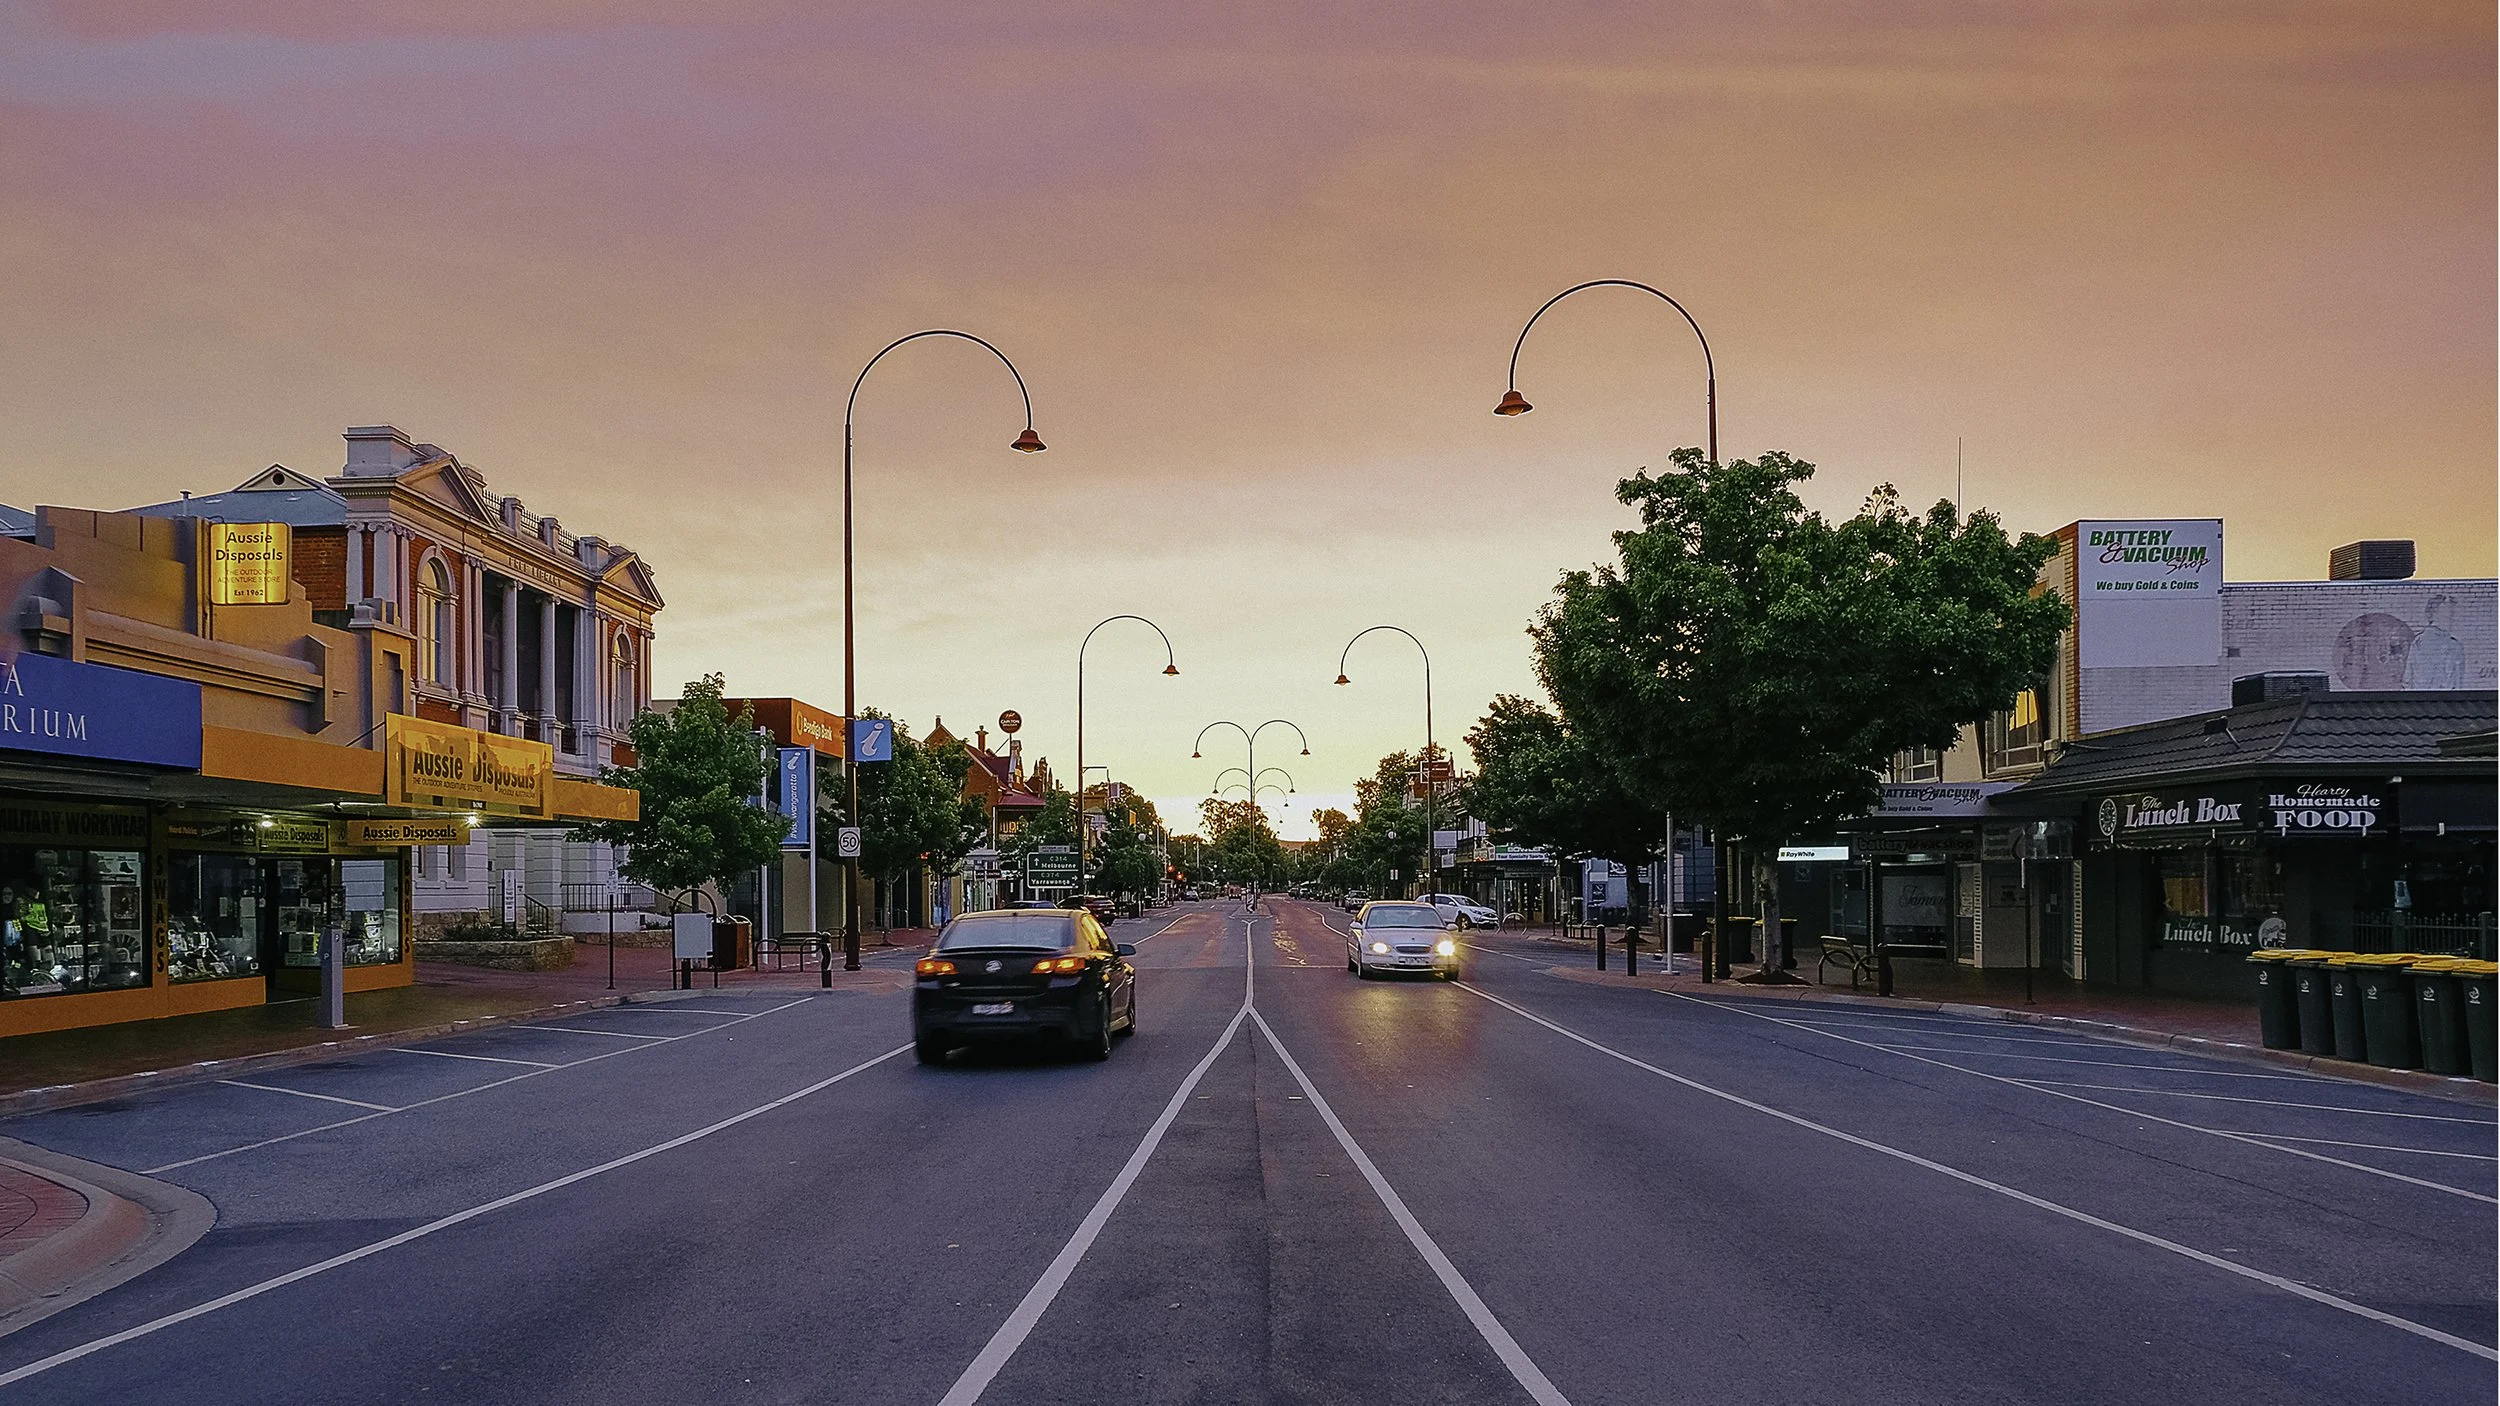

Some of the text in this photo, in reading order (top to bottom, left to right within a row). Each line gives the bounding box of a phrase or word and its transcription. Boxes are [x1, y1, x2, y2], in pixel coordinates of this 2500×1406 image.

[226, 532, 273, 543] Aussie
[2089, 530, 2173, 546] BATTERY
[216, 548, 283, 563] Disposals
[2123, 546, 2207, 562] VACUUM
[2165, 556, 2211, 575] Shop
[2096, 580, 2200, 591] We buy Gold & Coins
[0, 662, 24, 697] A
[3, 704, 87, 740] RIUM
[413, 742, 536, 792] Aussie Disposals
[1881, 788, 1926, 798] ATTERY
[1933, 788, 1981, 798] VACUUM
[2297, 784, 2350, 798] Hearty
[2141, 795, 2162, 811] The
[2269, 794, 2380, 806] Homemade
[2124, 797, 2242, 828] Lunch Box
[2274, 809, 2376, 828] FOOD
[290, 827, 325, 843] Disposals
[363, 825, 457, 840] Aussie Disposals
[842, 837, 856, 848] 50
[153, 854, 166, 973] SWAGS
[403, 861, 411, 954] BOOTS
[2163, 922, 2253, 946] Lunch Box
